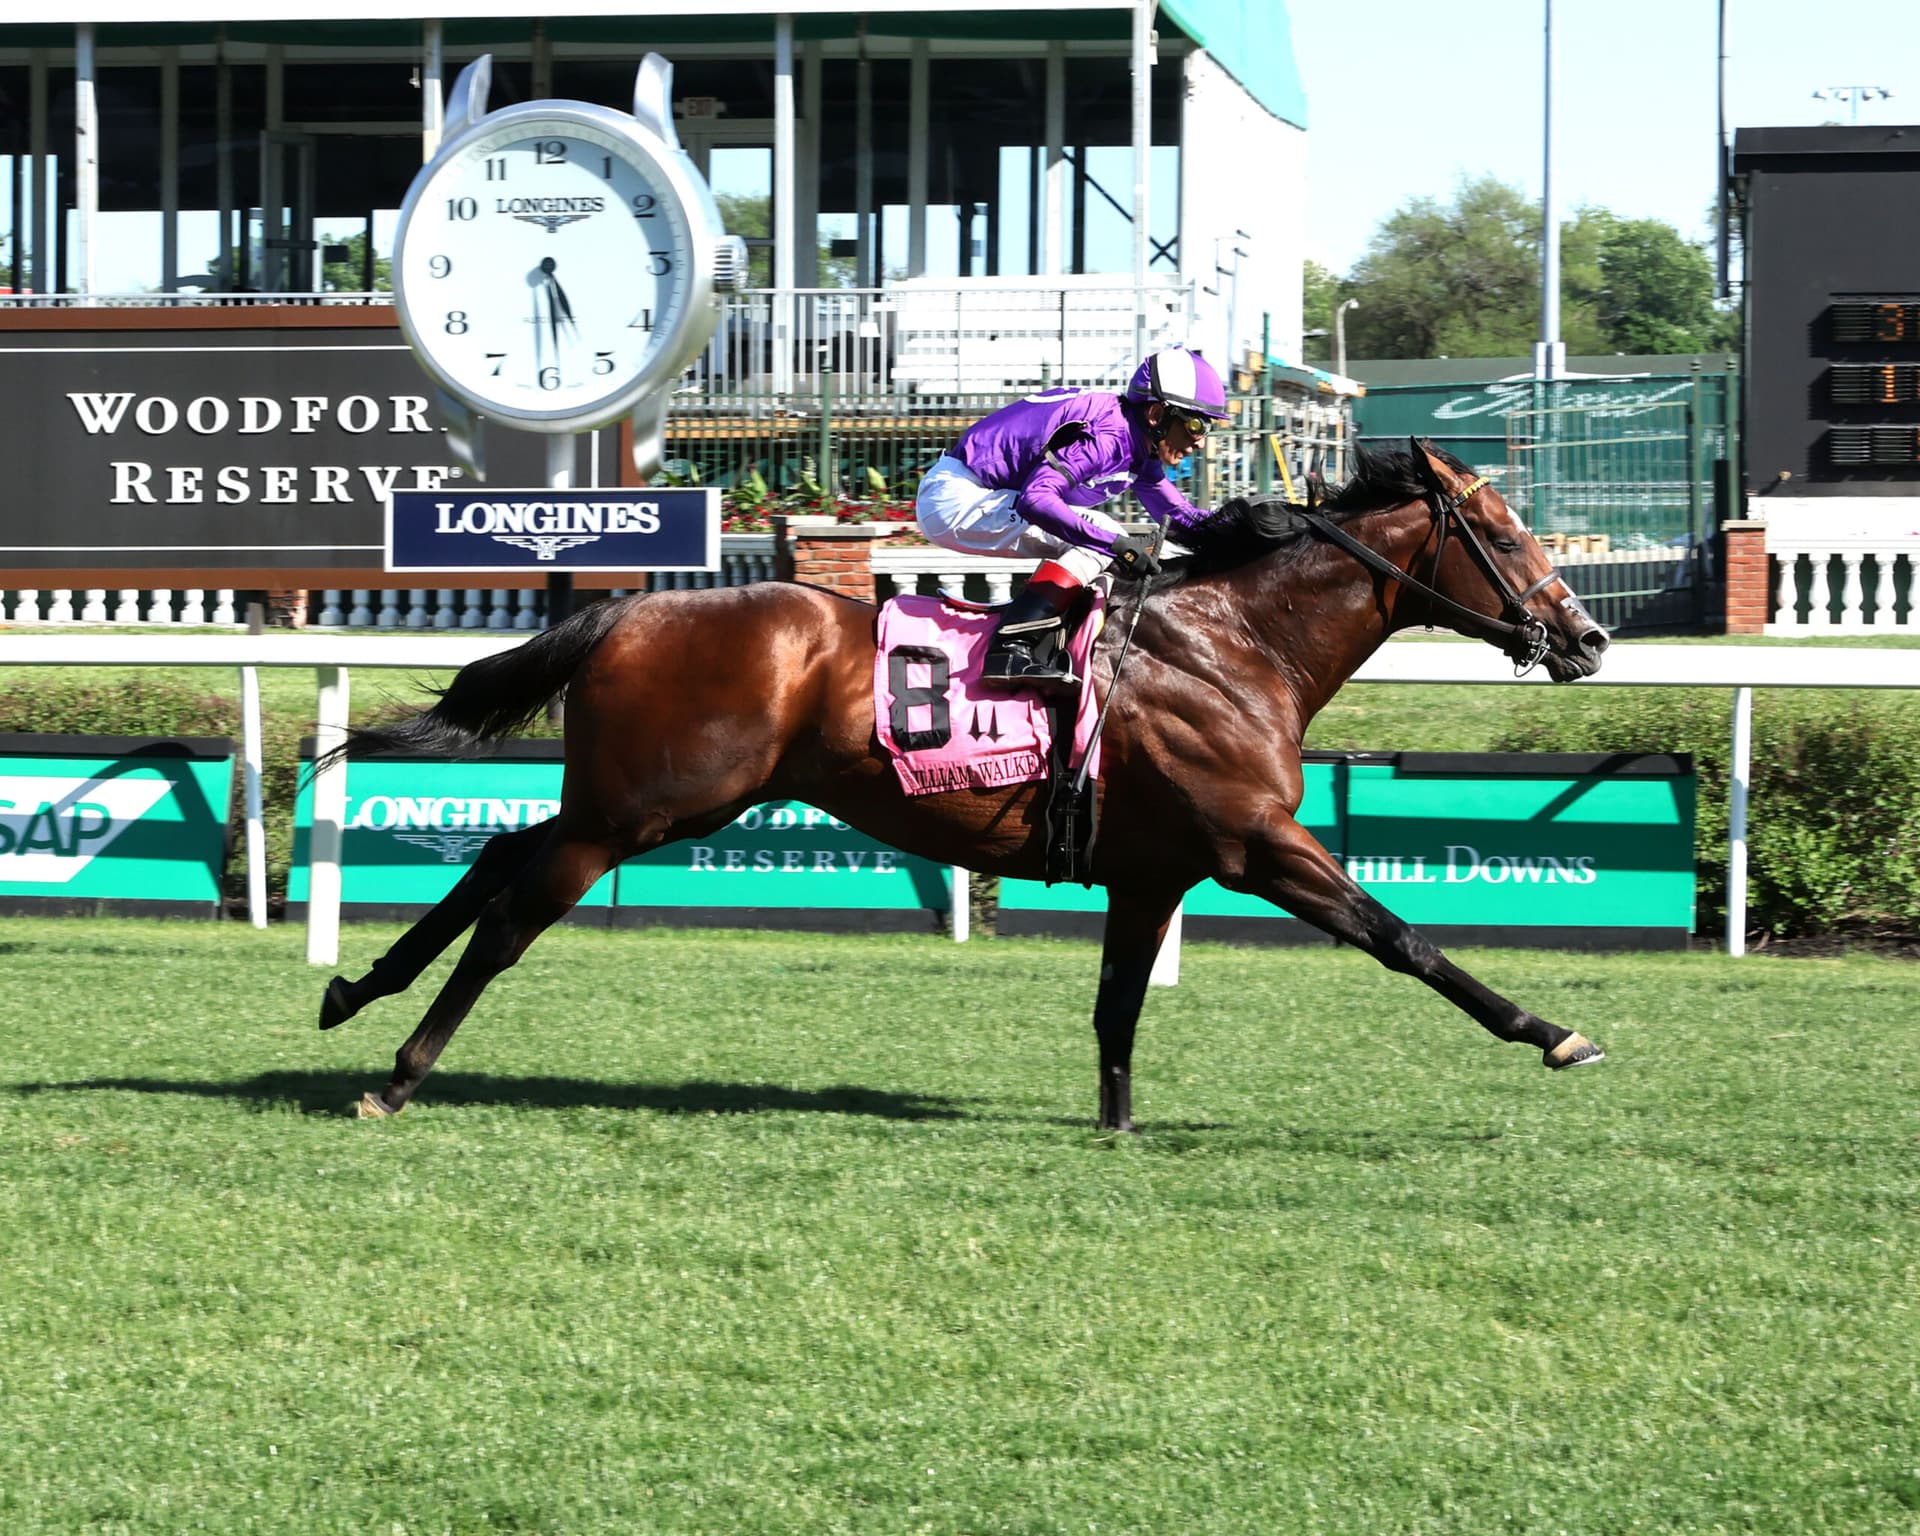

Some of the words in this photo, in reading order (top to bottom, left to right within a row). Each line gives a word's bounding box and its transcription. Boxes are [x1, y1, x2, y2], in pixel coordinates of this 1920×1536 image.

[534, 140, 568, 165] 12
[485, 158, 507, 181] 11
[602, 155, 614, 180] 1
[447, 196, 478, 222] 10
[496, 197, 605, 214] LONGINES
[632, 194, 656, 218] 2
[429, 254, 452, 280] 9
[647, 250, 671, 277] 3
[445, 310, 471, 336] 8
[627, 308, 656, 333] 4
[1876, 303, 1904, 340] 3
[485, 353, 508, 377] 7
[592, 351, 615, 376] 5
[538, 366, 562, 391] 6
[1880, 364, 1899, 402] 1
[66, 392, 448, 434] WOODFOR
[435, 502, 661, 534] LONGINES
[888, 645, 952, 752] 8
[911, 763, 975, 788] ILLIAM
[687, 846, 897, 873] RESERVE
[1329, 852, 1437, 884] HILL
[1442, 845, 1597, 884] DOWNS
